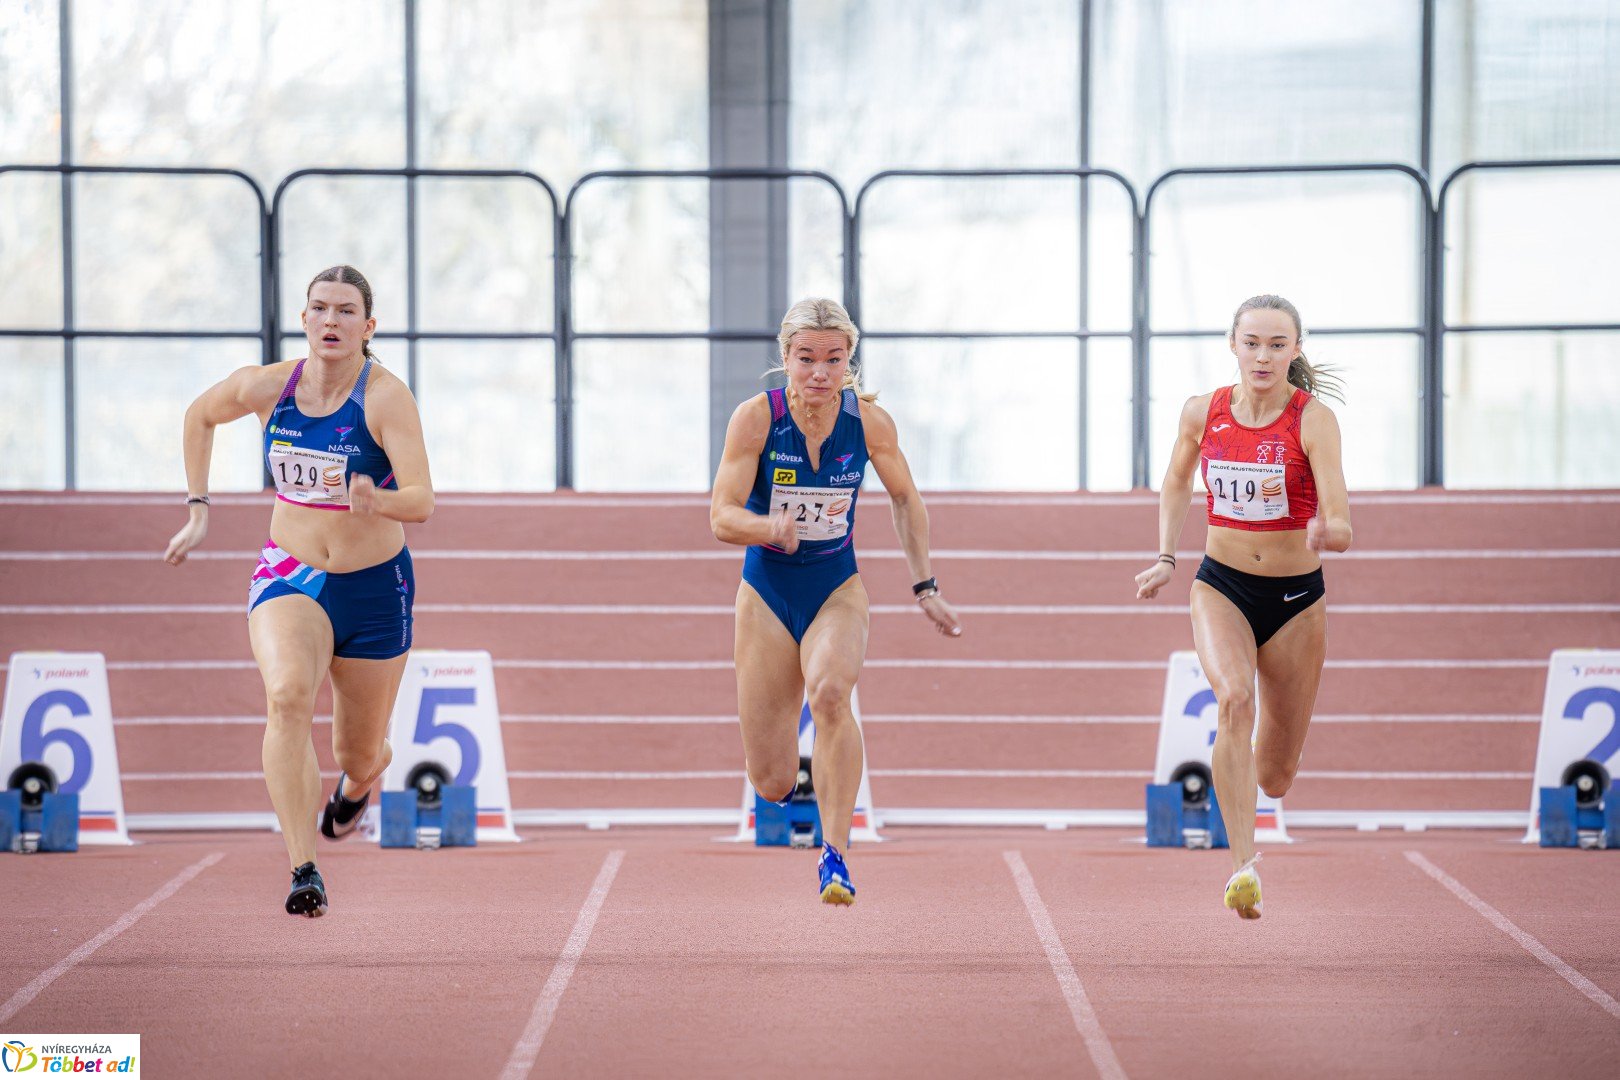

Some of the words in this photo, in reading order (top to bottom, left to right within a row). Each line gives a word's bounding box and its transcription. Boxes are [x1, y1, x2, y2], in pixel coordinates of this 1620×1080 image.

[276, 428, 302, 437] DÓVERA
[273, 448, 293, 456] HALOVÉ
[328, 444, 361, 453] NASA
[776, 453, 803, 462] DÓVERA
[278, 462, 318, 488] 129
[775, 471, 794, 482] SPP
[830, 470, 861, 483] NASA
[1214, 477, 1256, 503] 219
[781, 502, 824, 523] 127
[394, 564, 403, 584] NASA
[44, 668, 91, 679] polanik
[433, 666, 476, 677] polanik
[20, 689, 93, 794] 6
[412, 687, 481, 788] 5
[1562, 686, 1620, 790] 2
